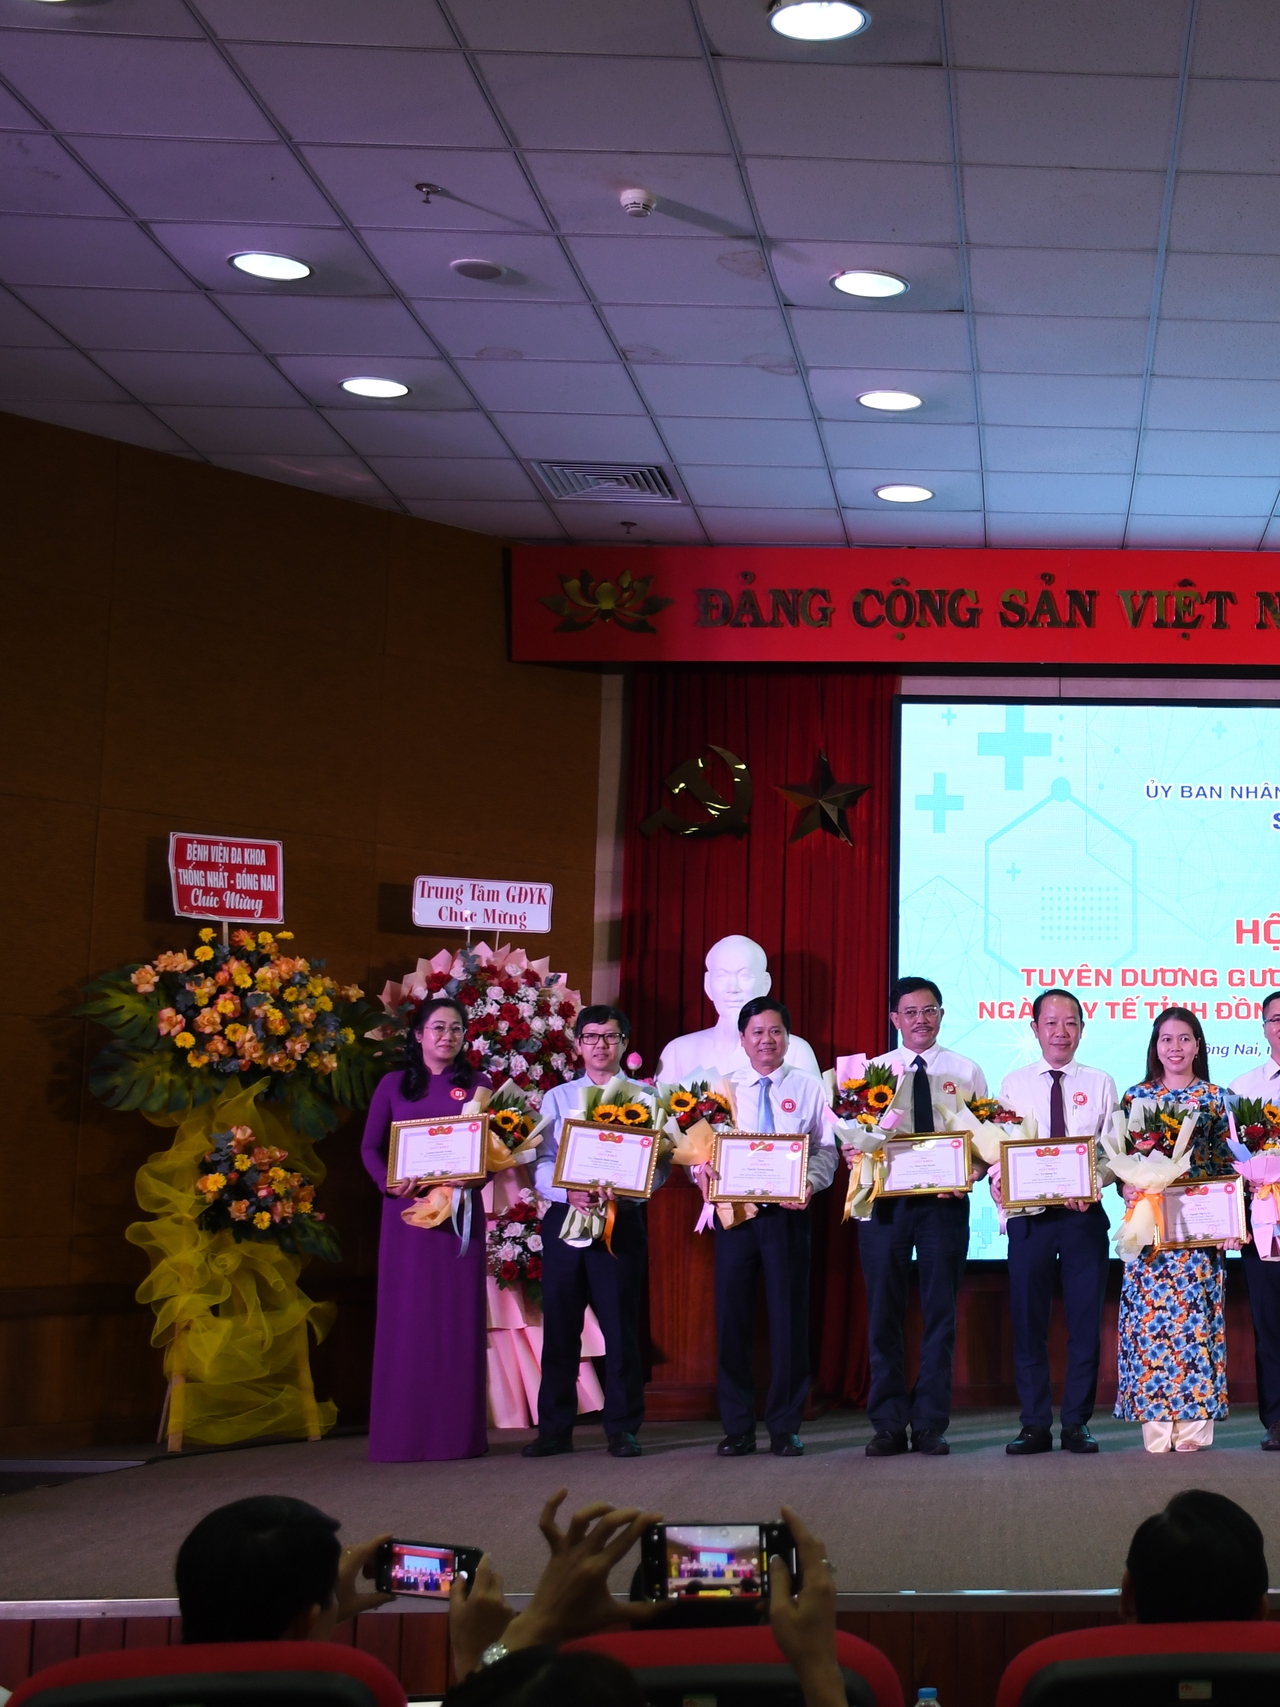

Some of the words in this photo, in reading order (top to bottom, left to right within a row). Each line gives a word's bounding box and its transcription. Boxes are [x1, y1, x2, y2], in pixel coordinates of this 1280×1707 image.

[695, 571, 835, 628] ĐẢNG
[852, 577, 983, 641] CỘNG
[998, 572, 1100, 628] SẢN
[1116, 578, 1238, 641] VIỆT
[1145, 780, 1172, 799] ỦY
[1181, 785, 1222, 800] BAN
[186, 841, 209, 864] BỆNH
[211, 843, 229, 866] VIỆN
[231, 847, 242, 865] ĐA
[244, 848, 267, 866] KHOA
[260, 875, 276, 892] NAI
[419, 880, 464, 905] Trung
[470, 883, 500, 902] Tâm
[506, 886, 548, 905] GĐYK
[191, 888, 220, 908] Chúc
[483, 908, 527, 930] Mừng
[1021, 963, 1112, 987] TUYÊN
[1121, 966, 1218, 987] DƯƠNG
[1082, 1002, 1099, 1019] Y
[1105, 995, 1140, 1019] TẾ
[1234, 1043, 1262, 1057] Nai,
